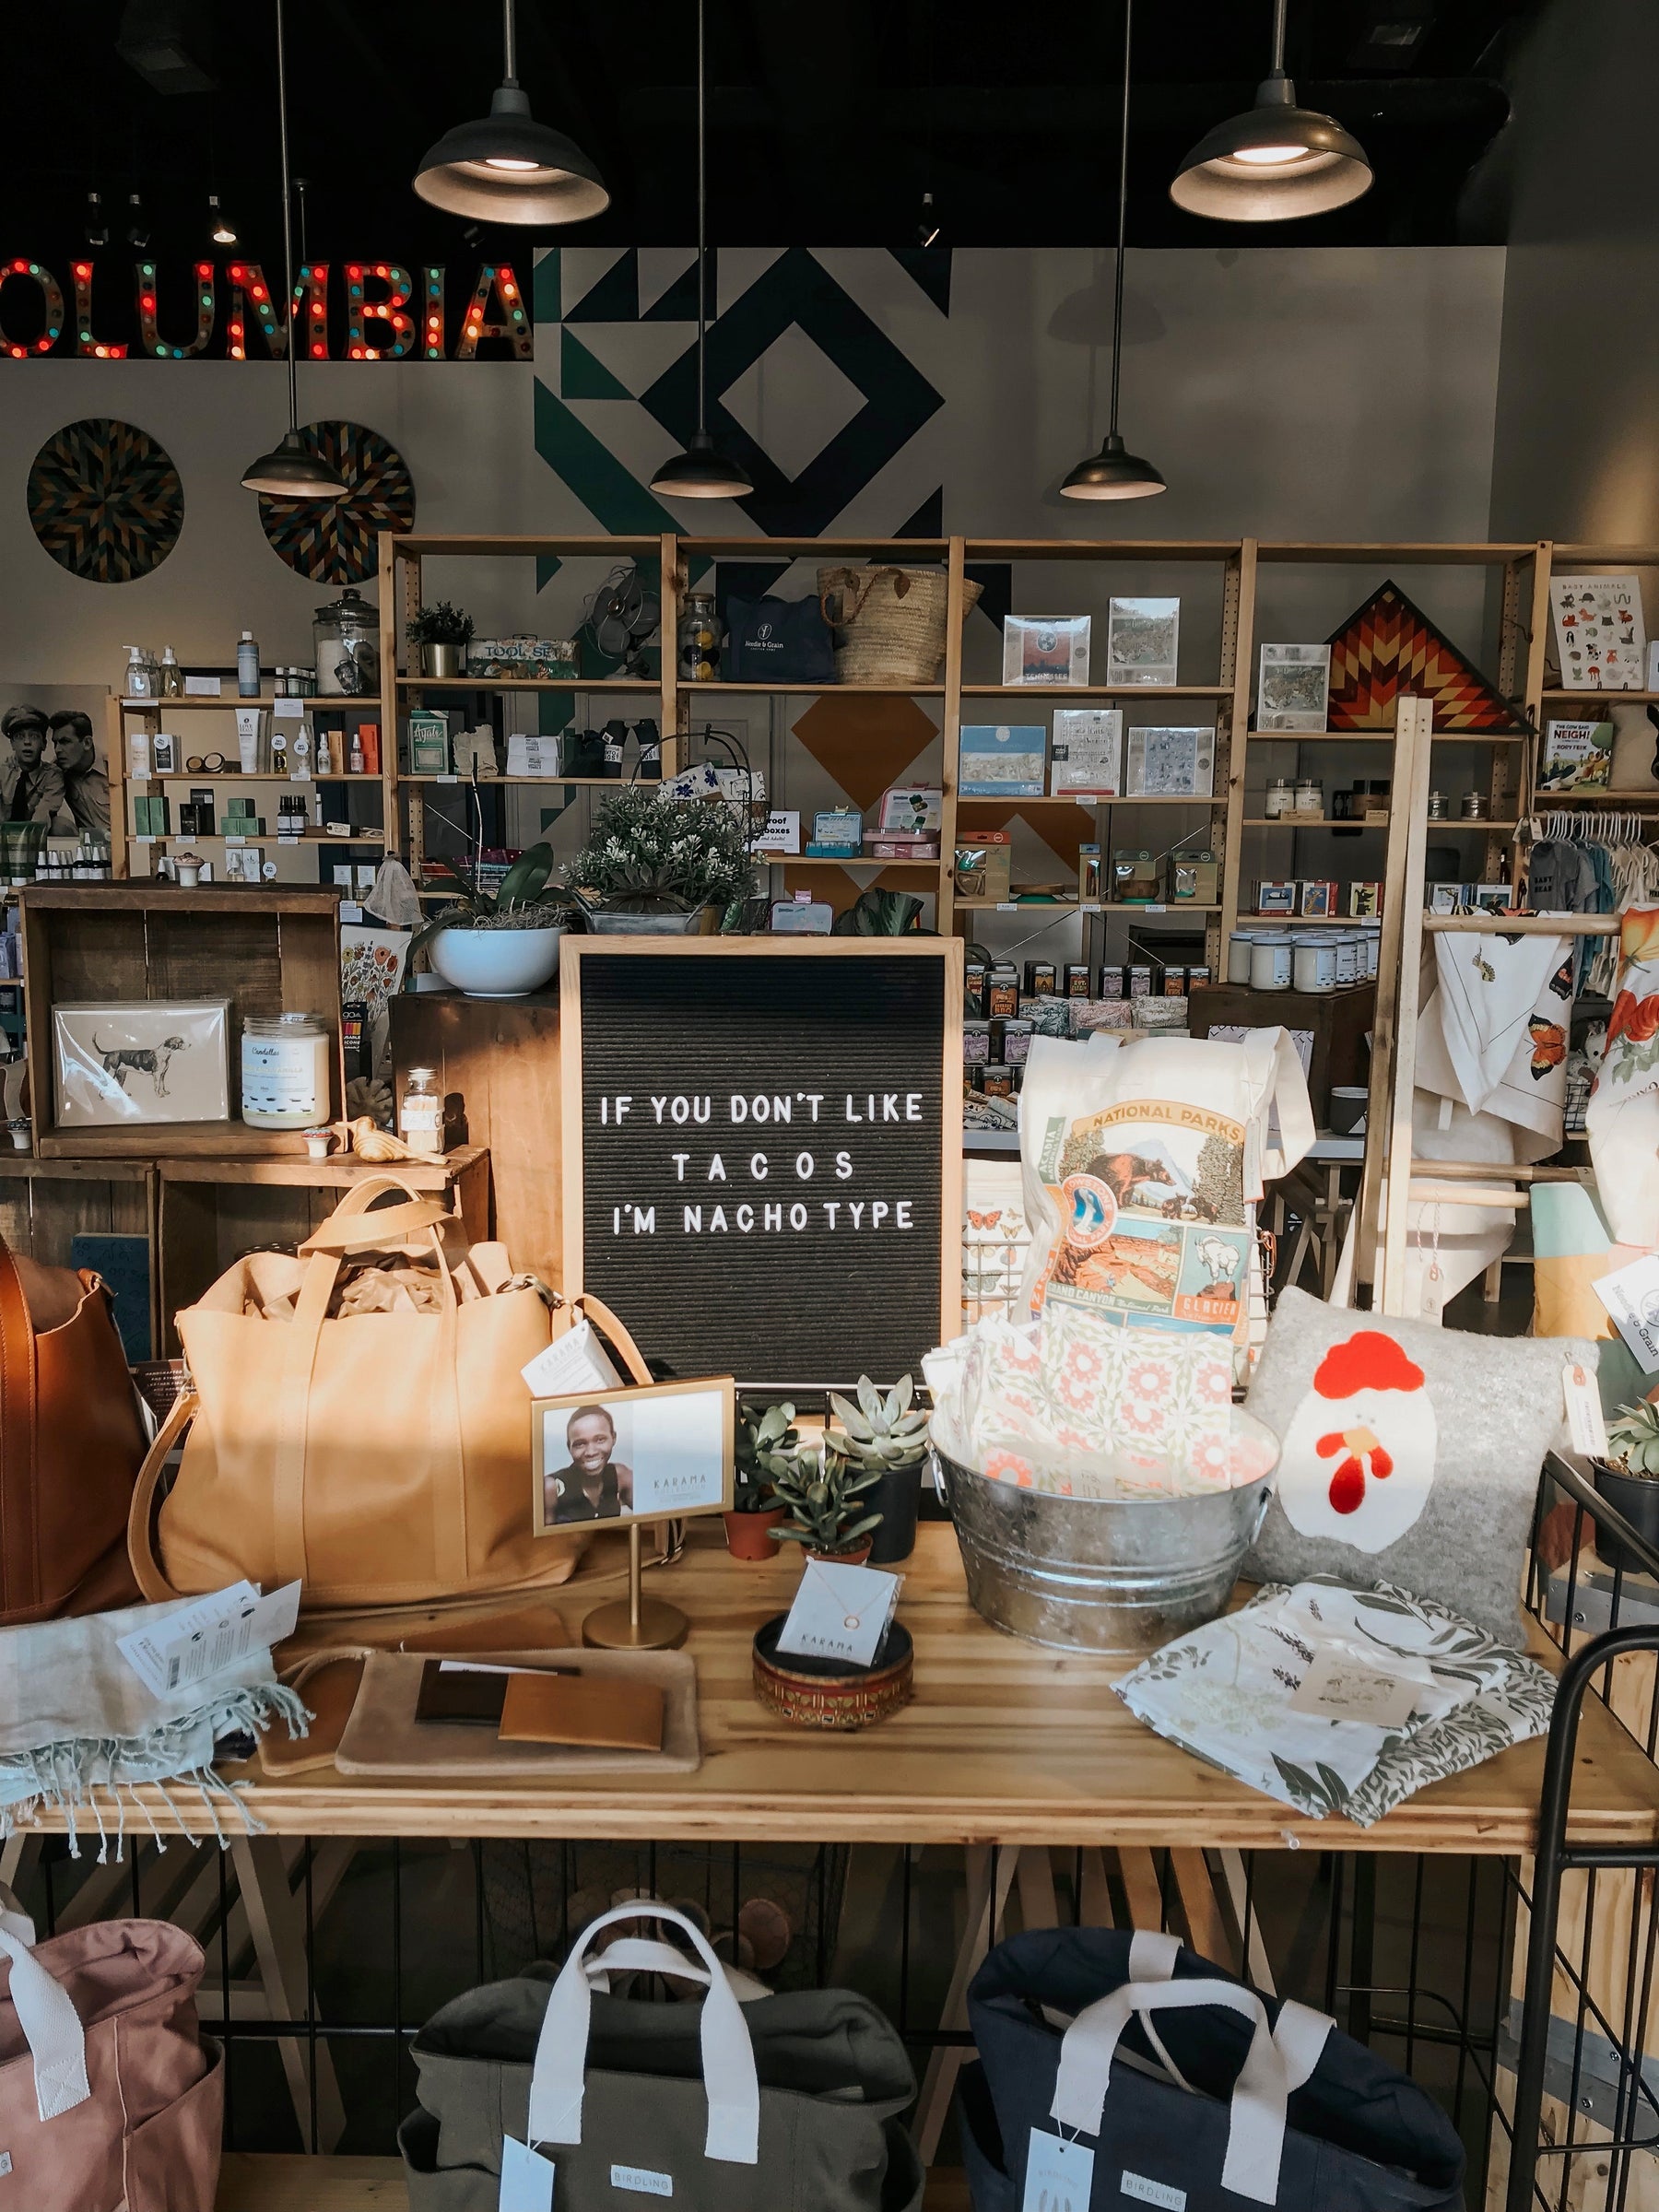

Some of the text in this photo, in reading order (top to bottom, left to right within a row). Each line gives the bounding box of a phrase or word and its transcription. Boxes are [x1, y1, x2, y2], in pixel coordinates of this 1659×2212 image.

[486, 646, 525, 657] TOOL
[1132, 731, 1146, 742] 500
[1553, 730, 1590, 739] NEIGH!
[1534, 877, 1553, 885] BABY
[601, 1092, 924, 1125] IF YOU DON'T LIKE
[1093, 1105, 1241, 1141] NATIONAL PARKS
[1039, 1130, 1057, 1172] ACADIA
[612, 1200, 913, 1235] I'M NACHO TYPE
[1048, 1282, 1170, 1313] GRAND CANYON National Park
[1183, 1296, 1237, 1316] GLACIER
[1611, 1284, 1636, 1320] Needle
[1638, 1327, 1659, 1358] Grain
[540, 1338, 581, 1372] KARAMA
[653, 1474, 708, 1489] KARAMA
[800, 1632, 853, 1653] KARAMA
[613, 2171, 671, 2192] BIRDLING
[1124, 2178, 1183, 2207] BIRDLING
